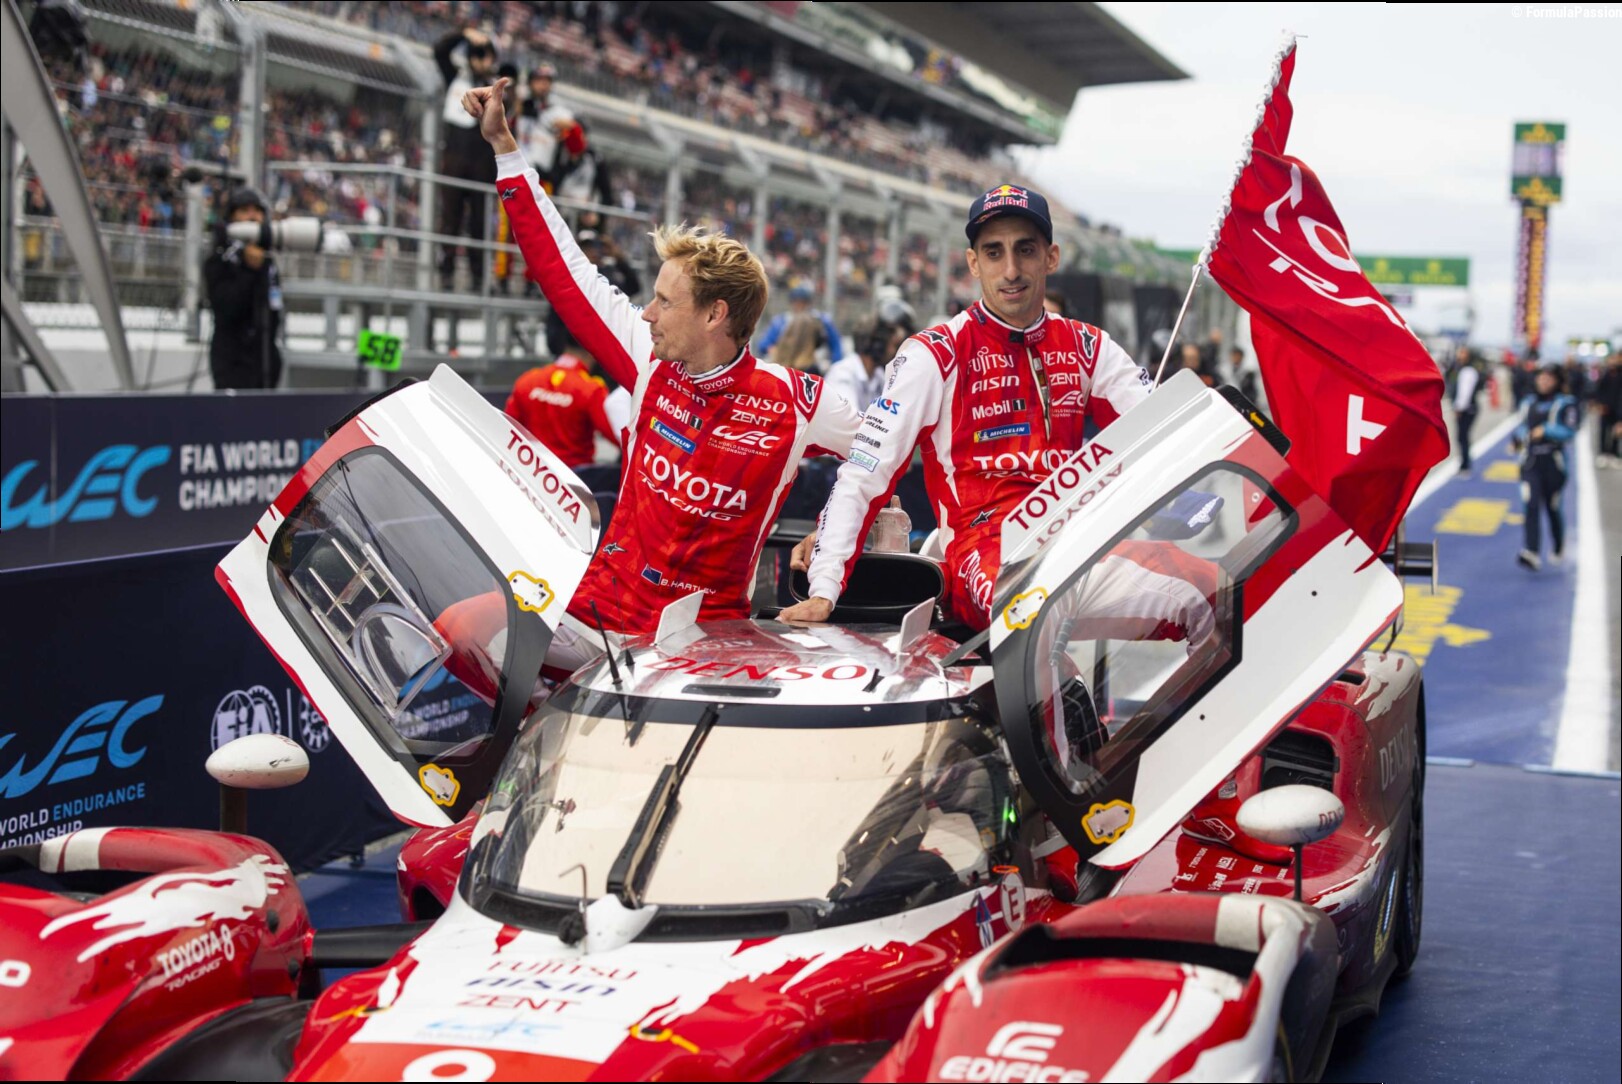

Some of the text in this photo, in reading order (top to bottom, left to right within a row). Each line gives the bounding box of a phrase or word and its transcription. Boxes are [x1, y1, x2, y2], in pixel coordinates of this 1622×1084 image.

[367, 336, 399, 365] 58
[967, 346, 1015, 375] UJITSU
[698, 376, 735, 390] TOYOTA
[1049, 373, 1080, 386] ZENT
[656, 394, 690, 424] Mobil
[730, 409, 772, 428] ZENT
[971, 400, 1011, 420] Mobil
[661, 428, 692, 450] MICHELIN
[712, 425, 781, 449] WEC
[989, 427, 1025, 437] MICHELIN
[180, 444, 218, 474] FIA
[222, 439, 299, 471] WORLD
[707, 441, 747, 456] CHAMPIONSHIP
[737, 445, 769, 457] ENDURANCE
[973, 449, 1076, 472] TOYOT
[0, 444, 172, 530] WEC
[507, 429, 581, 524] TOYOTA
[643, 443, 747, 511] TOYOTA
[1008, 442, 1114, 530] TOYOTA
[638, 470, 743, 521] RACING
[643, 656, 867, 681] DENSO
[0, 694, 165, 798] WEC
[53, 783, 146, 821] ENDURANCE
[157, 930, 221, 978] TOYOTA
[456, 994, 583, 1013] ZENT
[939, 1056, 1090, 1083] EDIFICE
